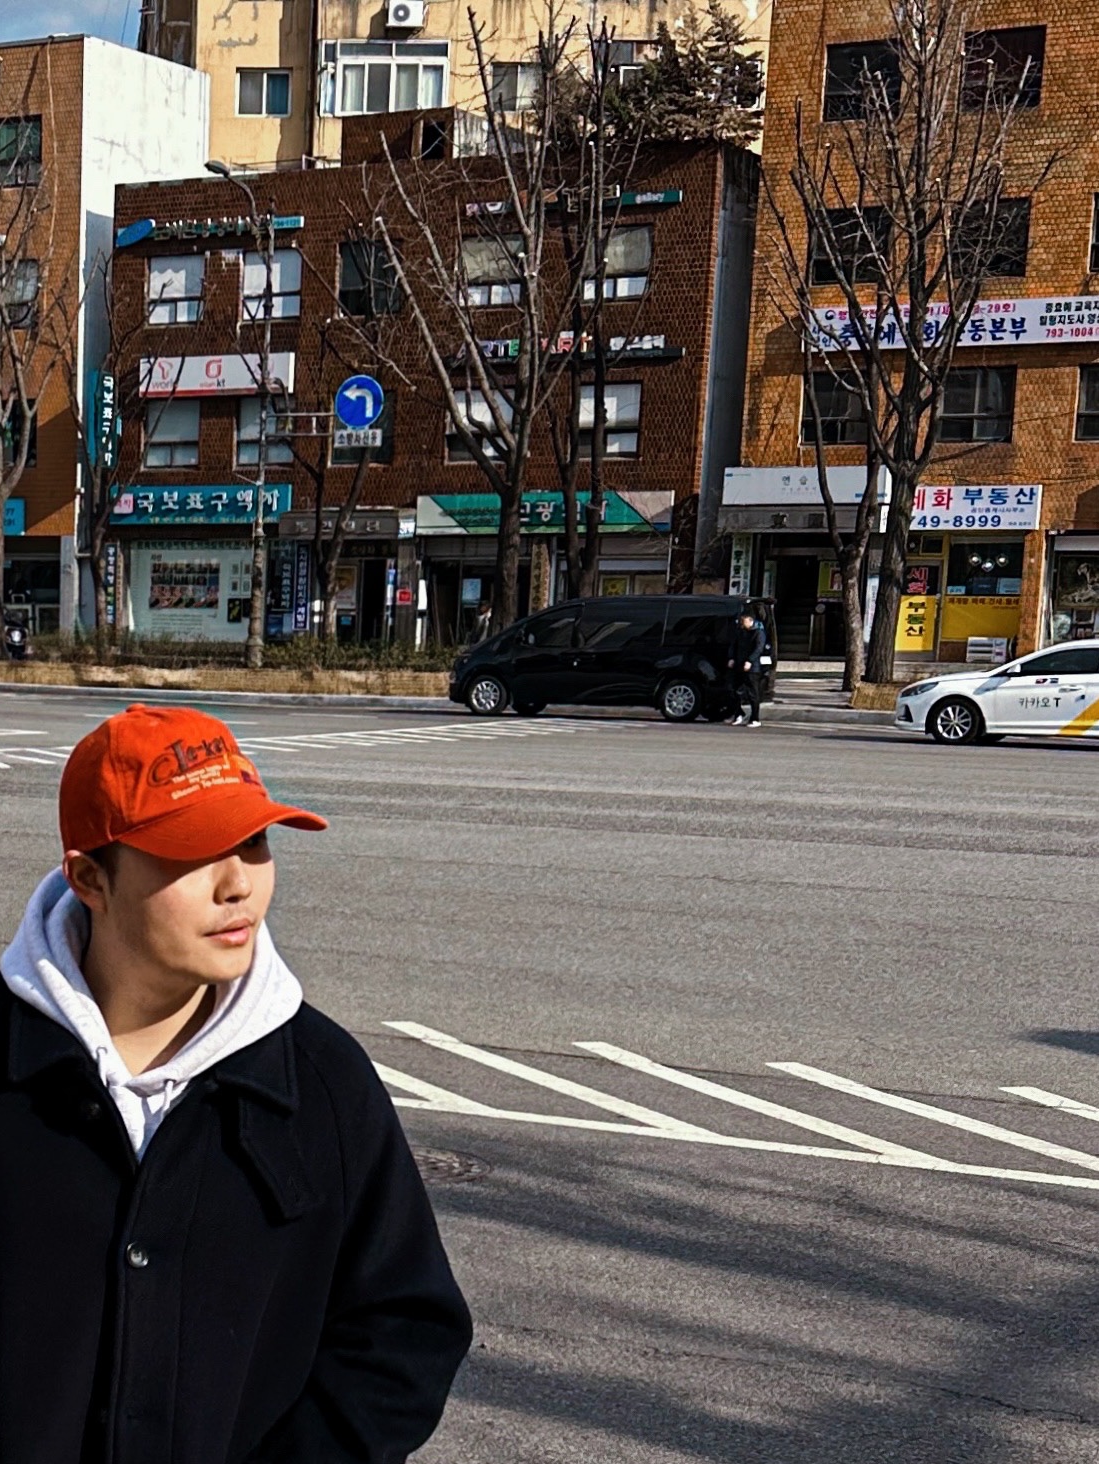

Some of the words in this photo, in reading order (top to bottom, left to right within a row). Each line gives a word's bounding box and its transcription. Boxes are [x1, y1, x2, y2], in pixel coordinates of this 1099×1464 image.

[839, 323, 896, 347] 충예
[906, 317, 1028, 344] 화동본부
[1045, 327, 1094, 338] 793-1004
[136, 489, 280, 513] 국보표구액자
[962, 486, 1037, 507] 부동산
[905, 602, 927, 637] 부동산
[1018, 697, 1051, 710] 카카오
[1053, 697, 1062, 707] T
